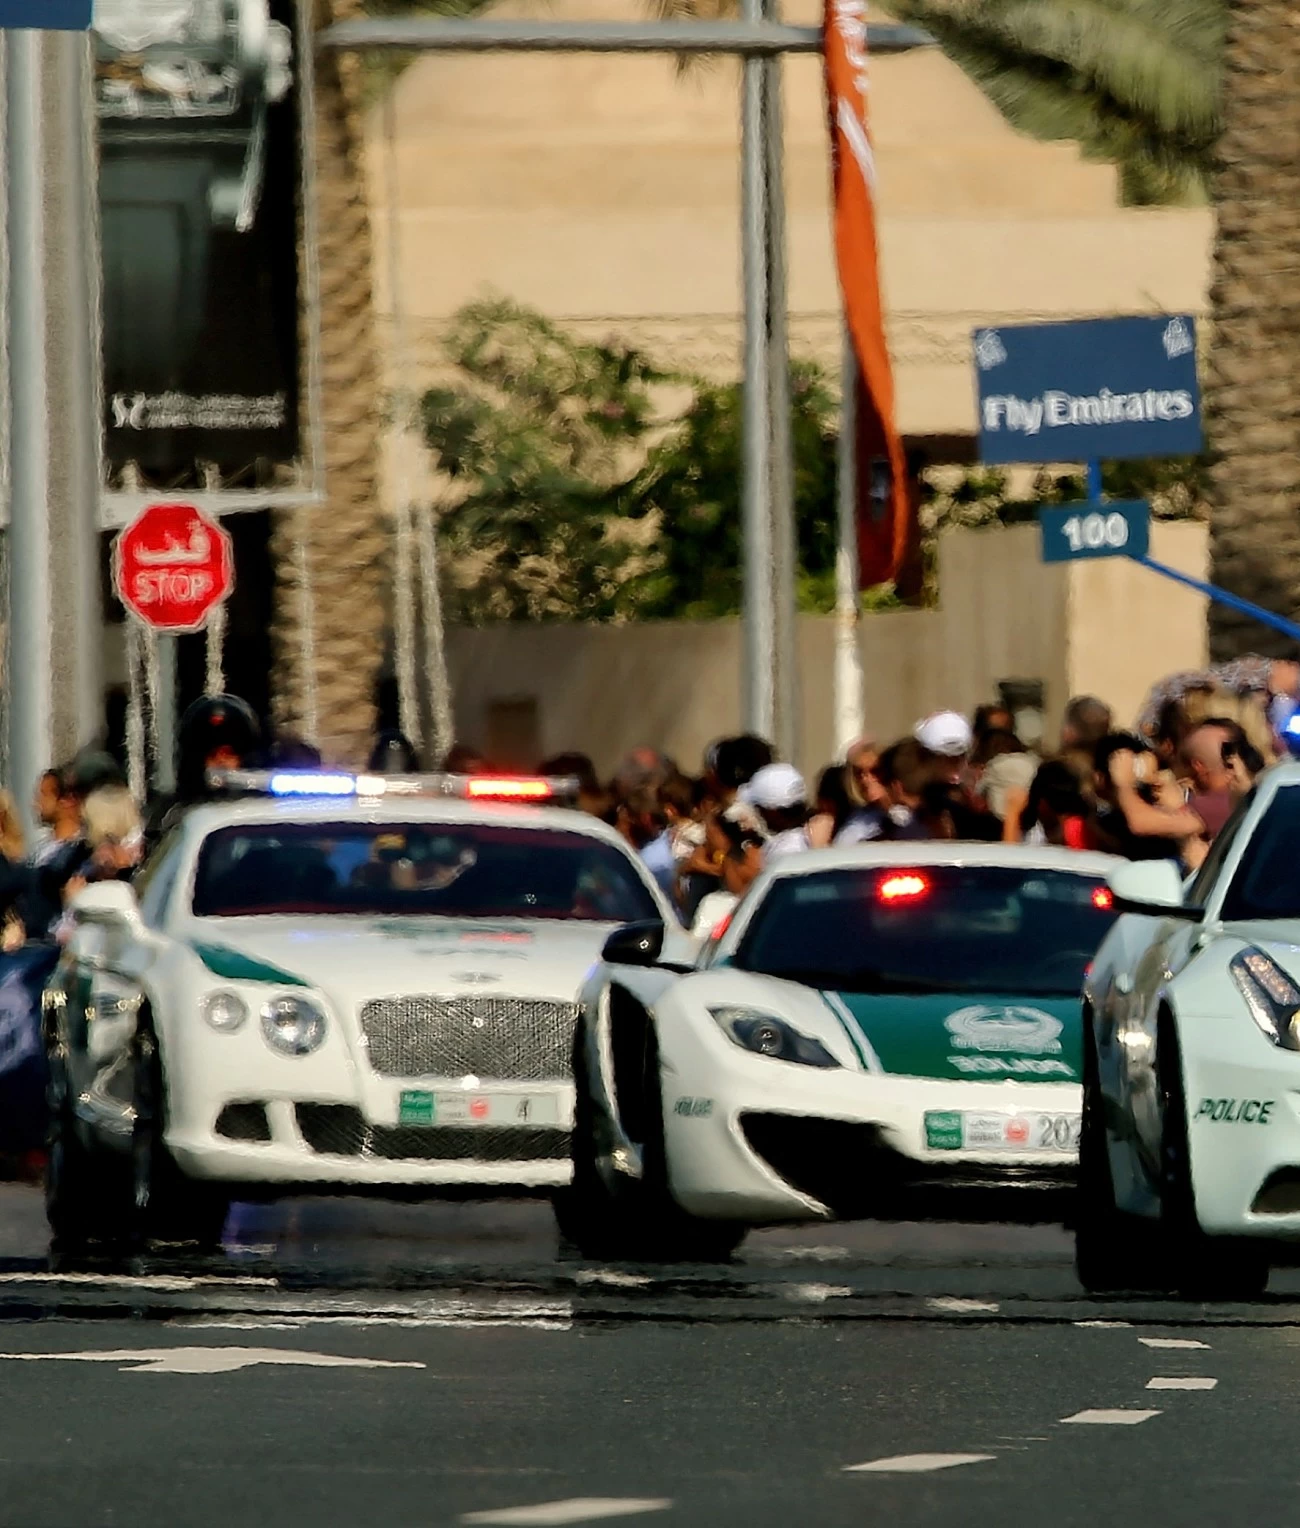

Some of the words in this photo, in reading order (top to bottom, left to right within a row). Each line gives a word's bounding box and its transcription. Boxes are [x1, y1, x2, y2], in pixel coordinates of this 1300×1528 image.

[983, 394, 1043, 436] Fly
[1043, 388, 1194, 428] Emirates
[1061, 511, 1129, 552] 100
[133, 568, 214, 606] STOP
[1194, 1098, 1275, 1124] POLICE
